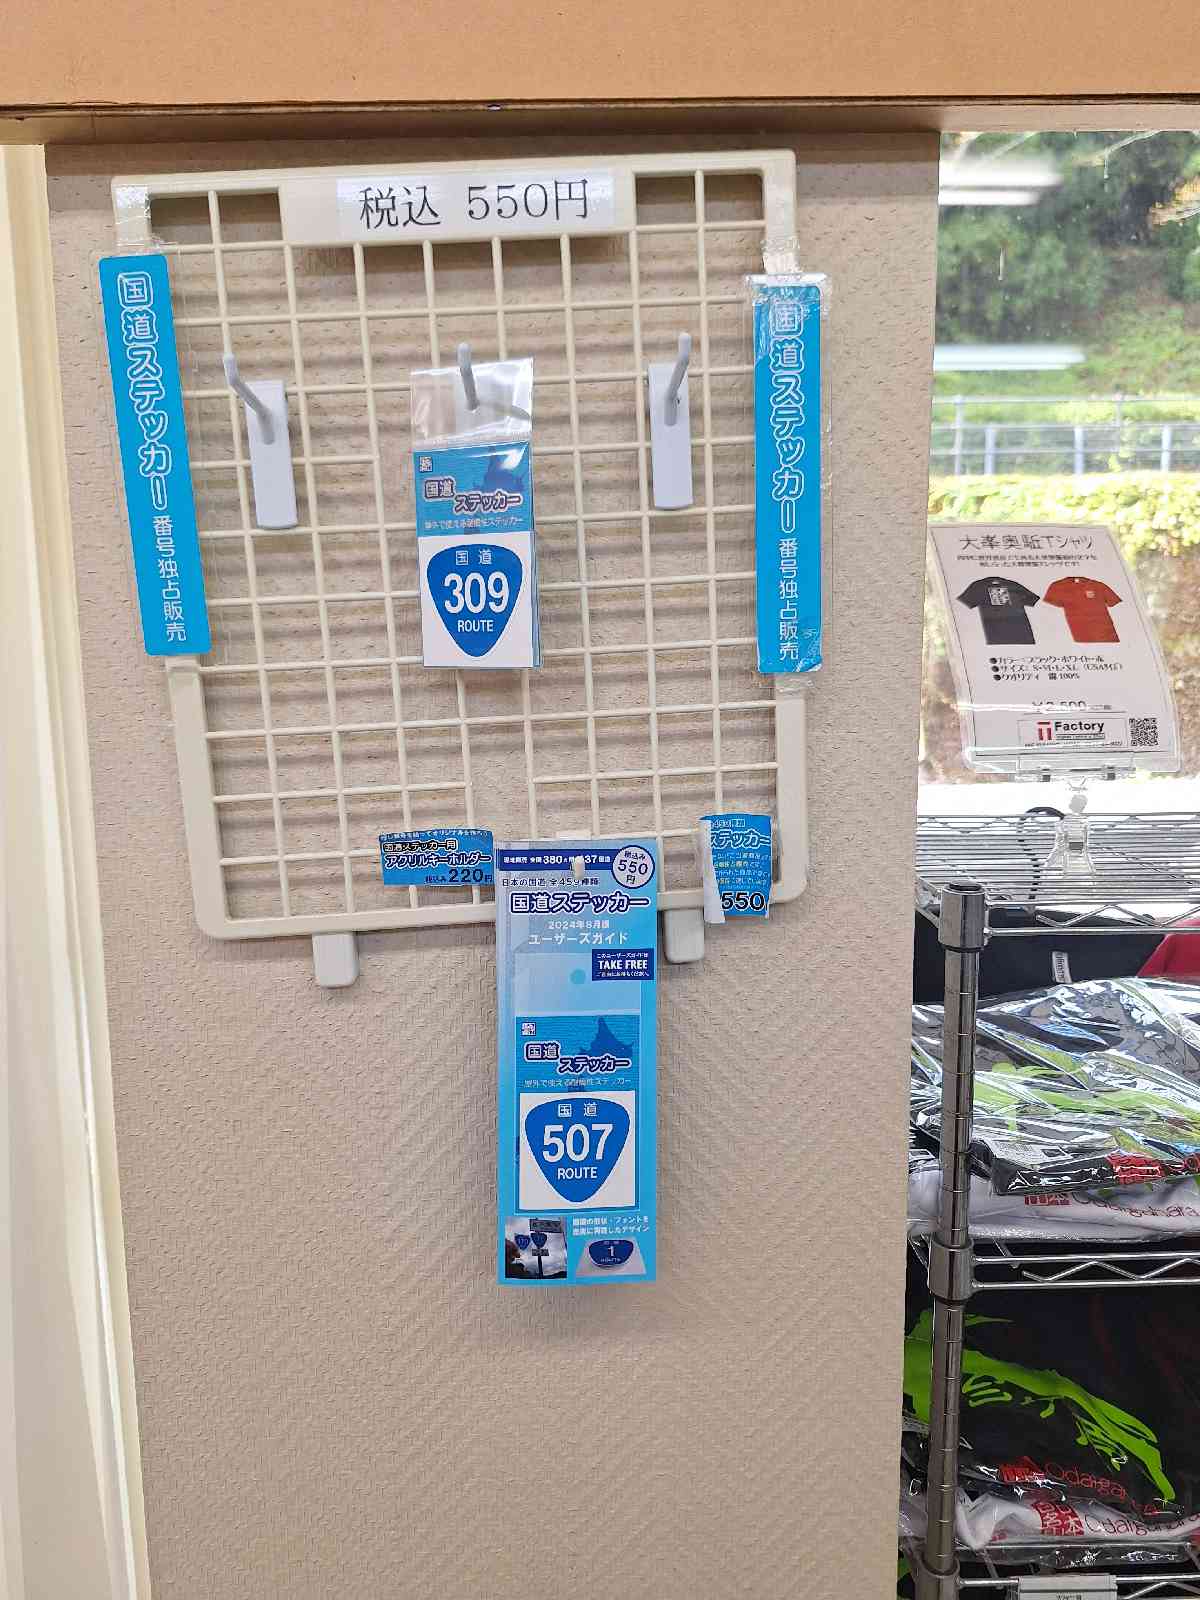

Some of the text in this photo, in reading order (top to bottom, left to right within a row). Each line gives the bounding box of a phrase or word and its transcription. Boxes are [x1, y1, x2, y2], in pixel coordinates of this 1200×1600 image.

[359, 179, 588, 229] 税込 550円
[116, 271, 187, 642] 国道ステッカー 番号独占販売
[425, 479, 454, 499] 国道
[454, 492, 522, 513] ステッカー
[444, 571, 510, 614] 309
[778, 538, 800, 661] 番号独占販売
[457, 619, 494, 633] ROUTE
[1054, 721, 1105, 732] Factory
[384, 852, 493, 869] アクリルキーホルダー
[617, 859, 649, 875] 550
[626, 875, 636, 884] 円
[510, 891, 651, 915] 国道ステッカー
[528, 932, 629, 945] ユーザーズガイド
[598, 959, 648, 970] TAKE FREE
[525, 1042, 560, 1060] 国道
[558, 1054, 631, 1073] ステッカー
[542, 1123, 614, 1163] 507
[557, 1166, 598, 1180] ROUTE
